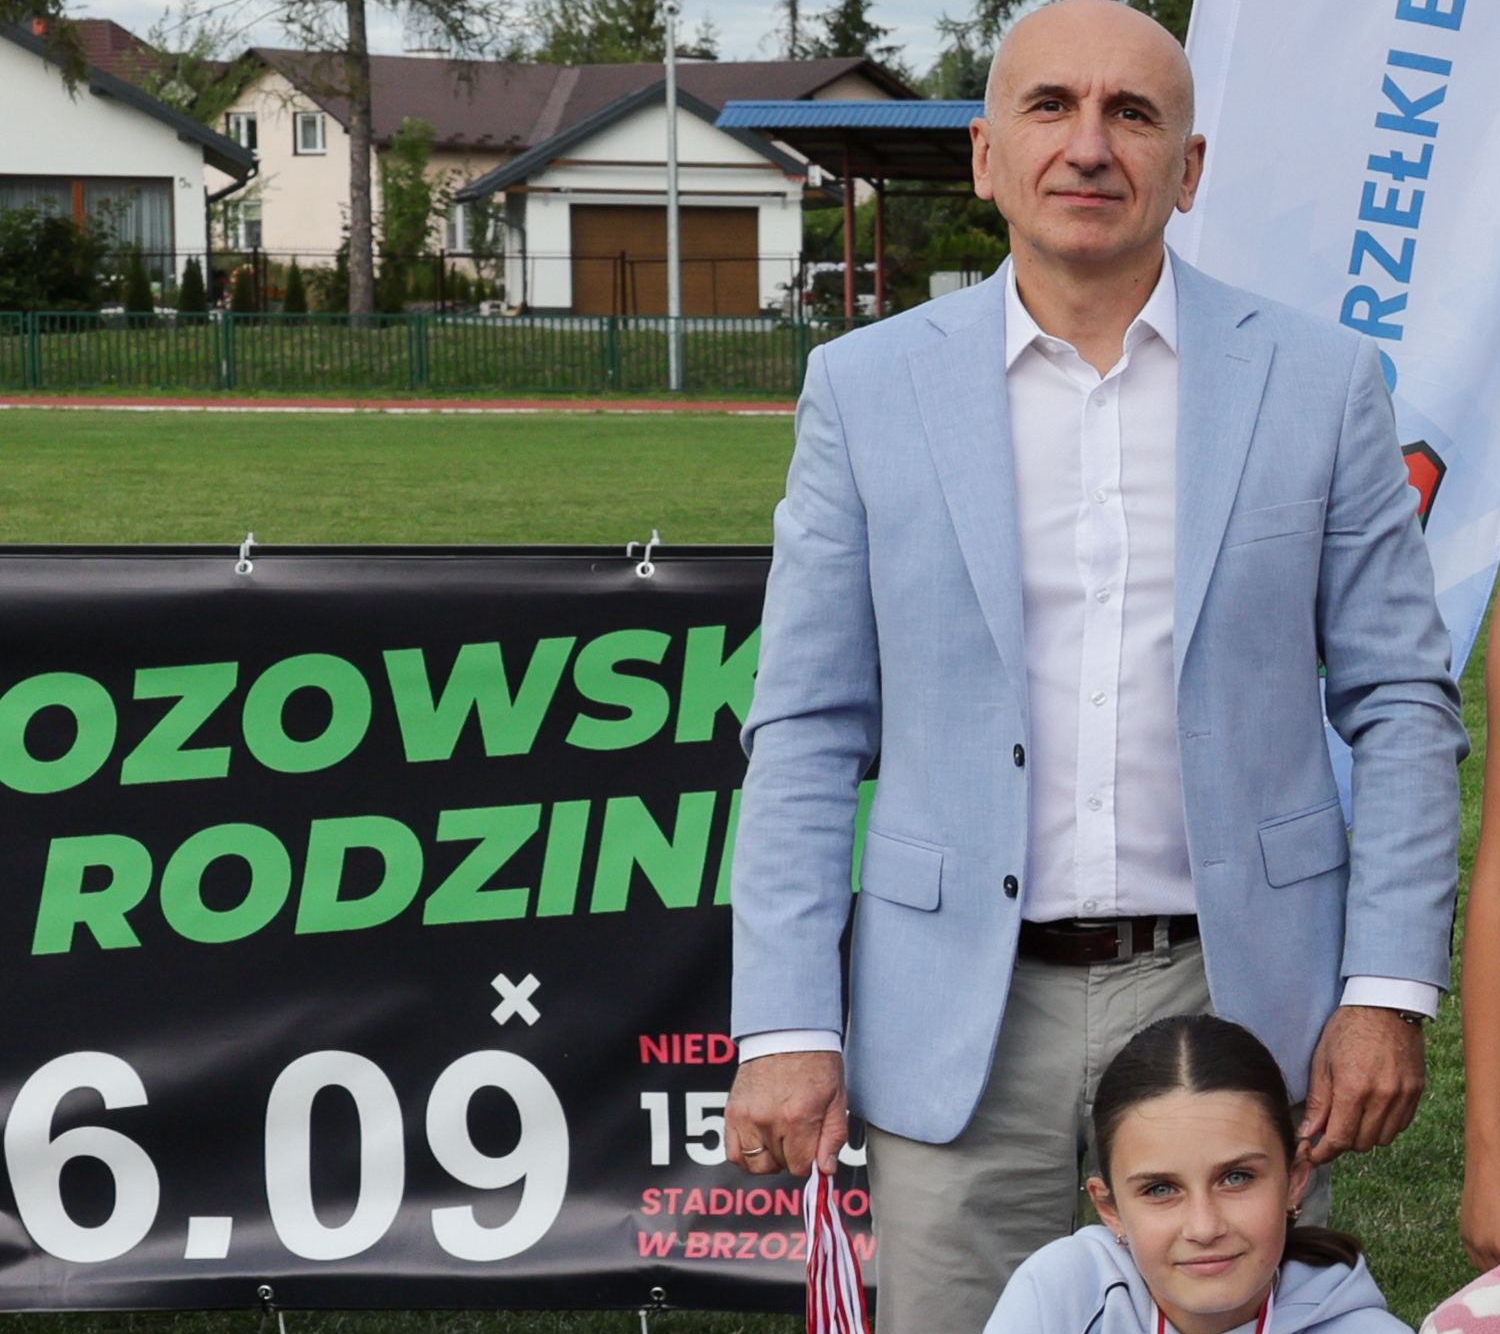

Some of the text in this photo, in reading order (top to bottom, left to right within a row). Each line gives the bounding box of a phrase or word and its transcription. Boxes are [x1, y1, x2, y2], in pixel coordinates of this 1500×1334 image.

[1339, 49, 1454, 385] RZEŁKI
[31, 779, 879, 955] RODZIN
[637, 1231, 877, 1260] W BRZOZW
[640, 1187, 799, 1216] STADION
